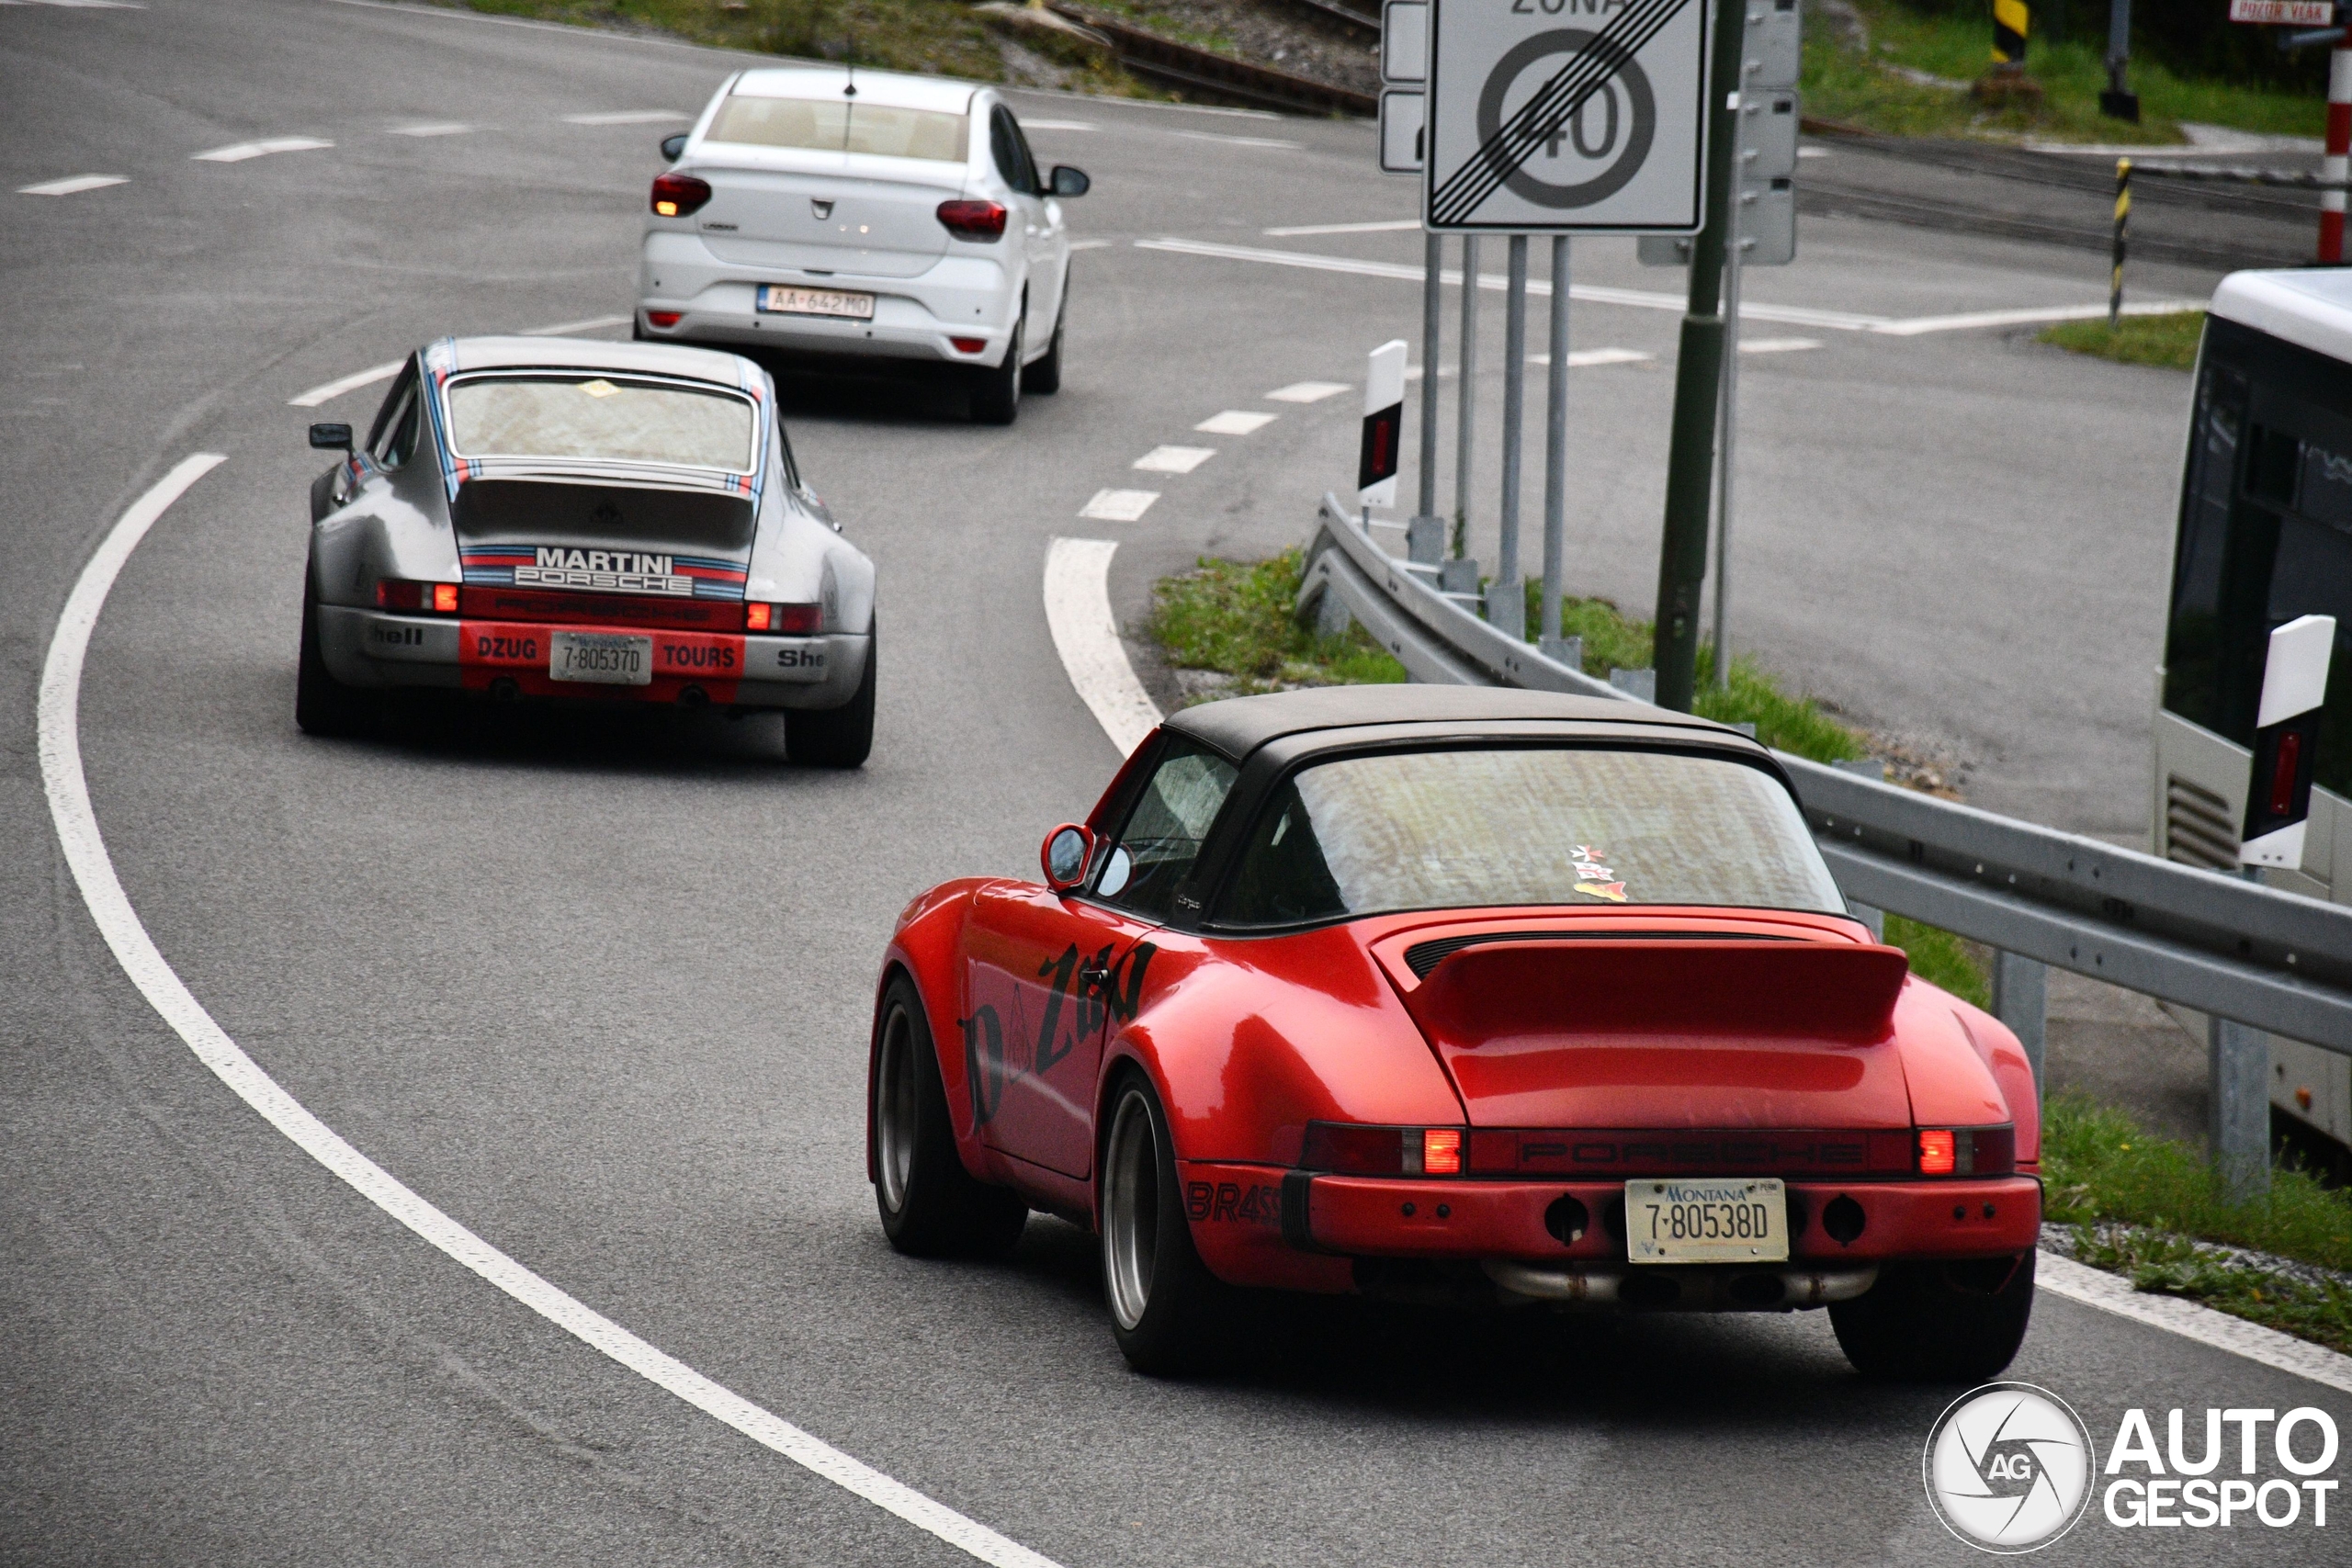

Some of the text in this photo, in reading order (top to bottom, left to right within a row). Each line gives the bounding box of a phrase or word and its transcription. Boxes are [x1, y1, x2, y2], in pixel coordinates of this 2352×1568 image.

[1517, 79, 1619, 160] 40
[536, 547, 673, 575] MARTINI
[514, 568, 693, 594] PORSCHE
[478, 636, 734, 668] DZUG TOURS
[1521, 1142, 1863, 1164] PORSCHE
